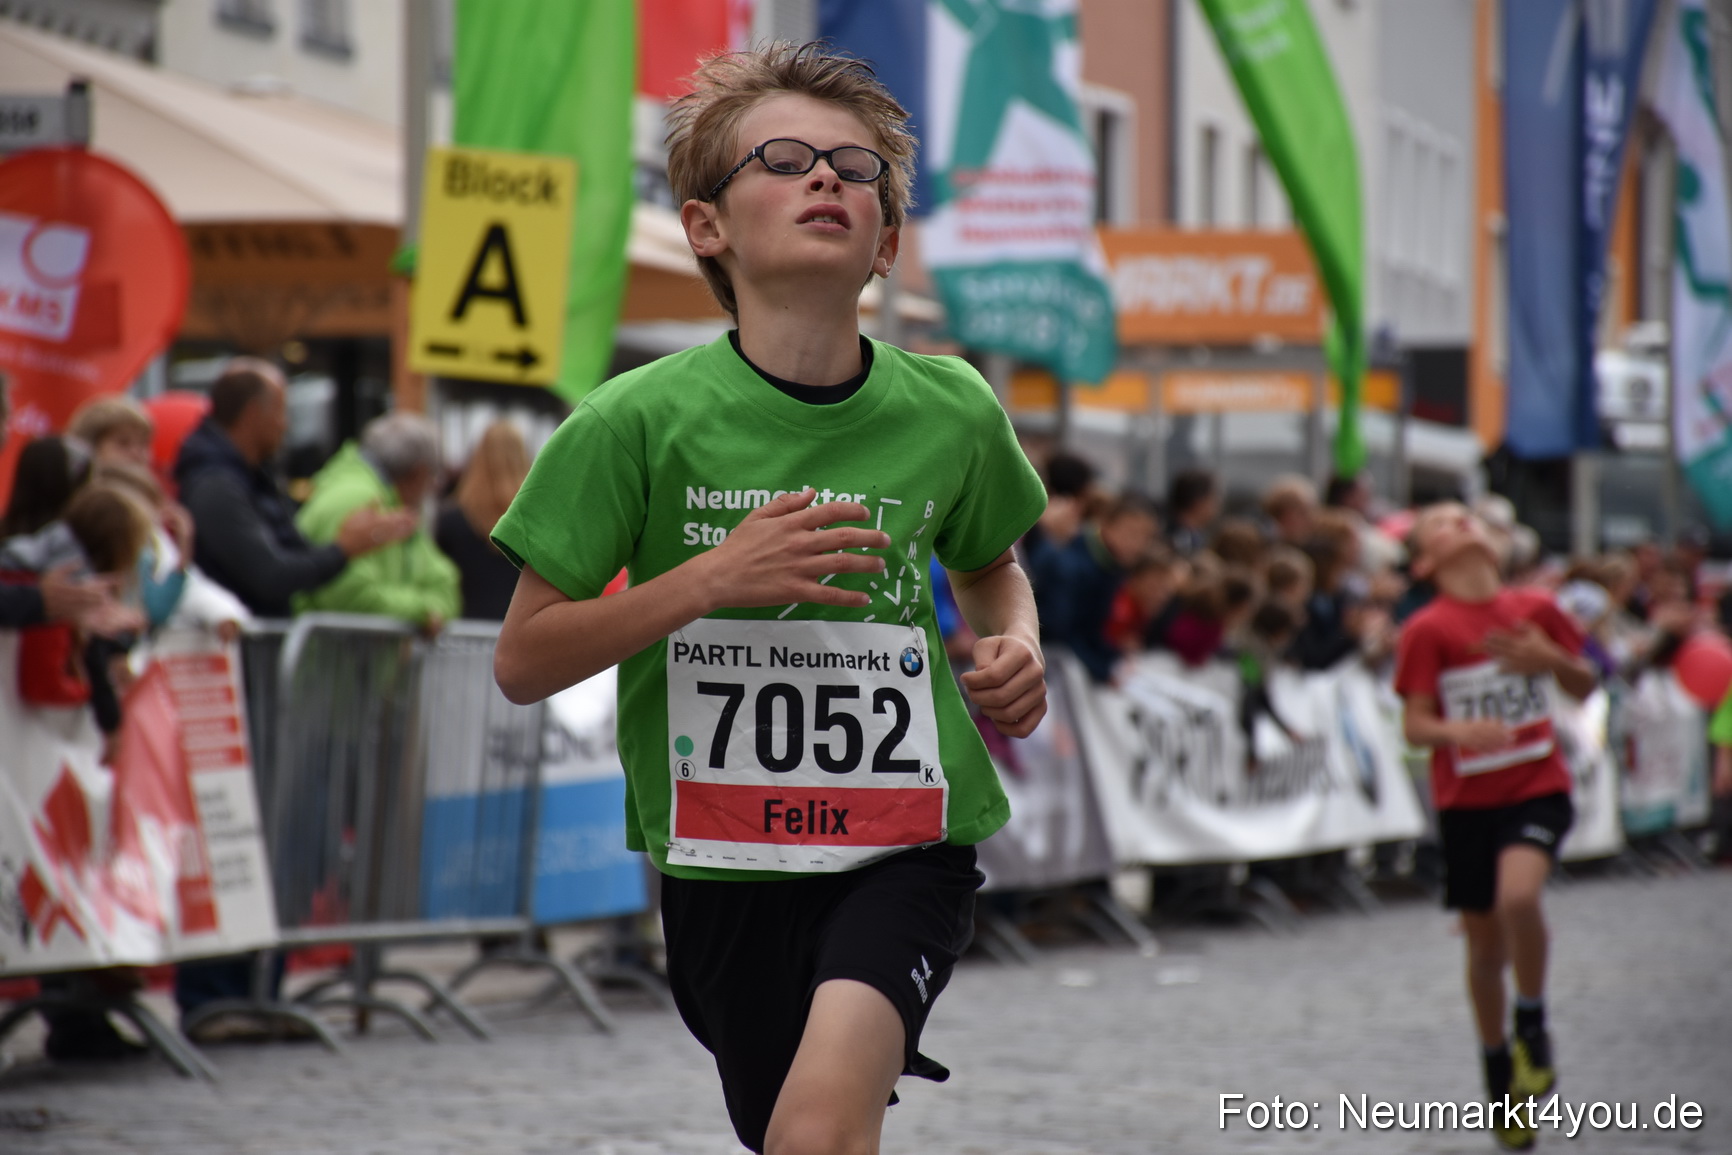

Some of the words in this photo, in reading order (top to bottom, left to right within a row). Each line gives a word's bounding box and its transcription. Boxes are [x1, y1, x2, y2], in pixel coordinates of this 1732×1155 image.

[445, 156, 560, 207] Block
[451, 221, 528, 329] A
[674, 642, 761, 668] PARTL
[769, 646, 890, 671] Neumarkt
[696, 680, 921, 774] 7052
[681, 763, 690, 777] 6
[925, 768, 935, 783] K
[764, 799, 849, 835] Felix
